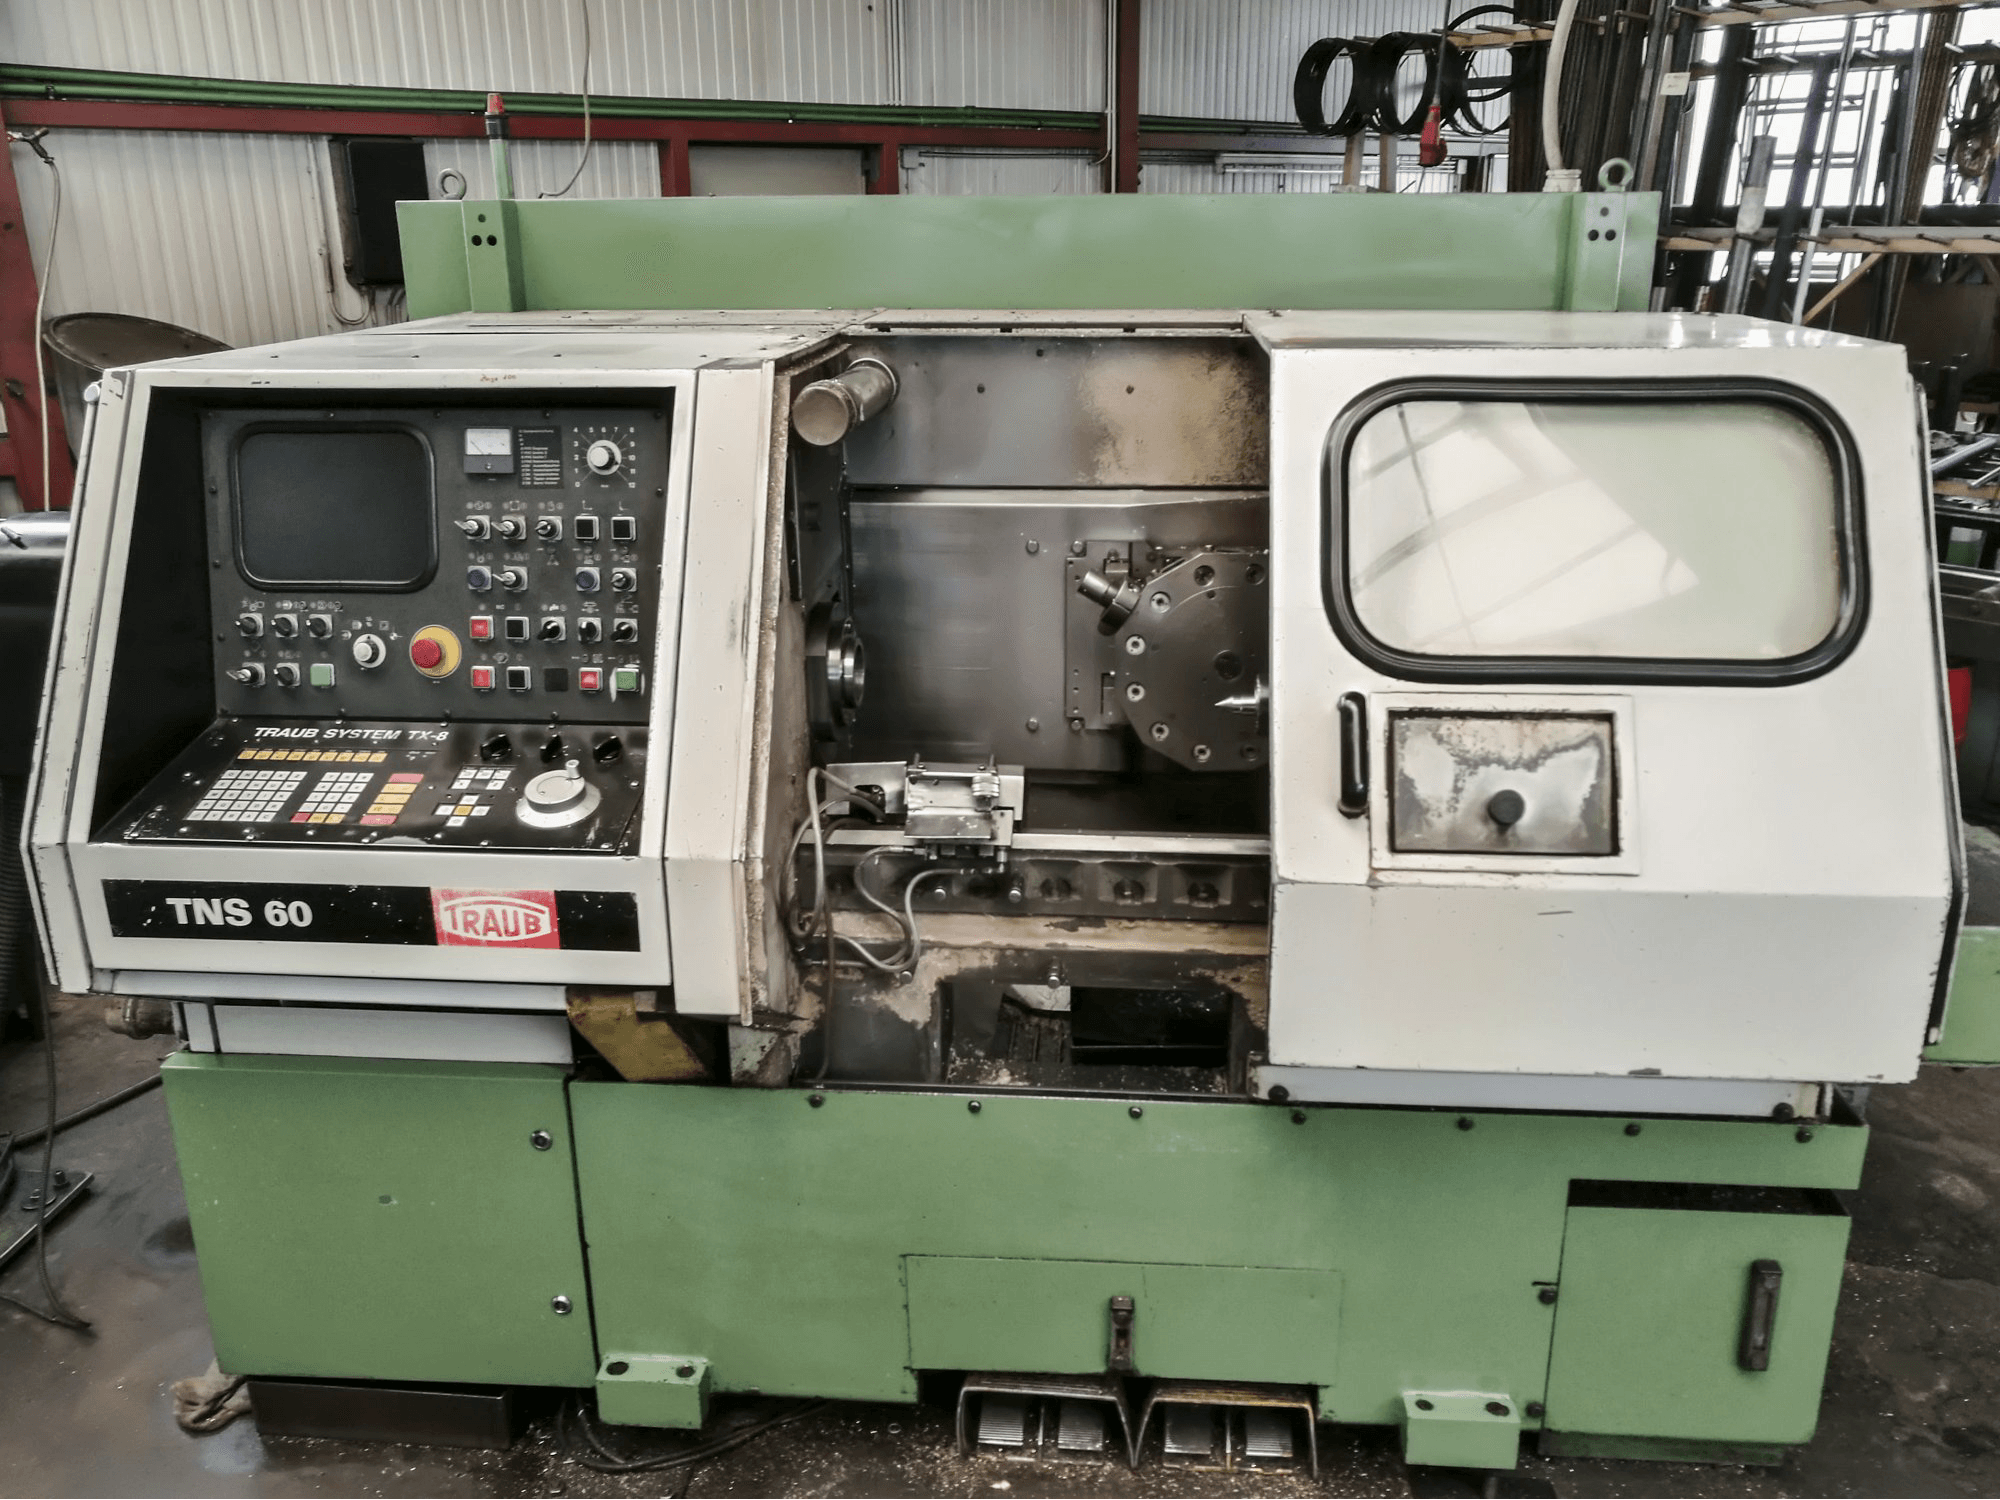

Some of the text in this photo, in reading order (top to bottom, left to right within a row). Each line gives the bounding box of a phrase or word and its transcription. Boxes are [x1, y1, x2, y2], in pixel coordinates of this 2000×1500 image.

[254, 727, 450, 740] TRAUB SYSTEM TX-8
[165, 897, 312, 928] TNS 60
[444, 900, 545, 937] TRAUB
